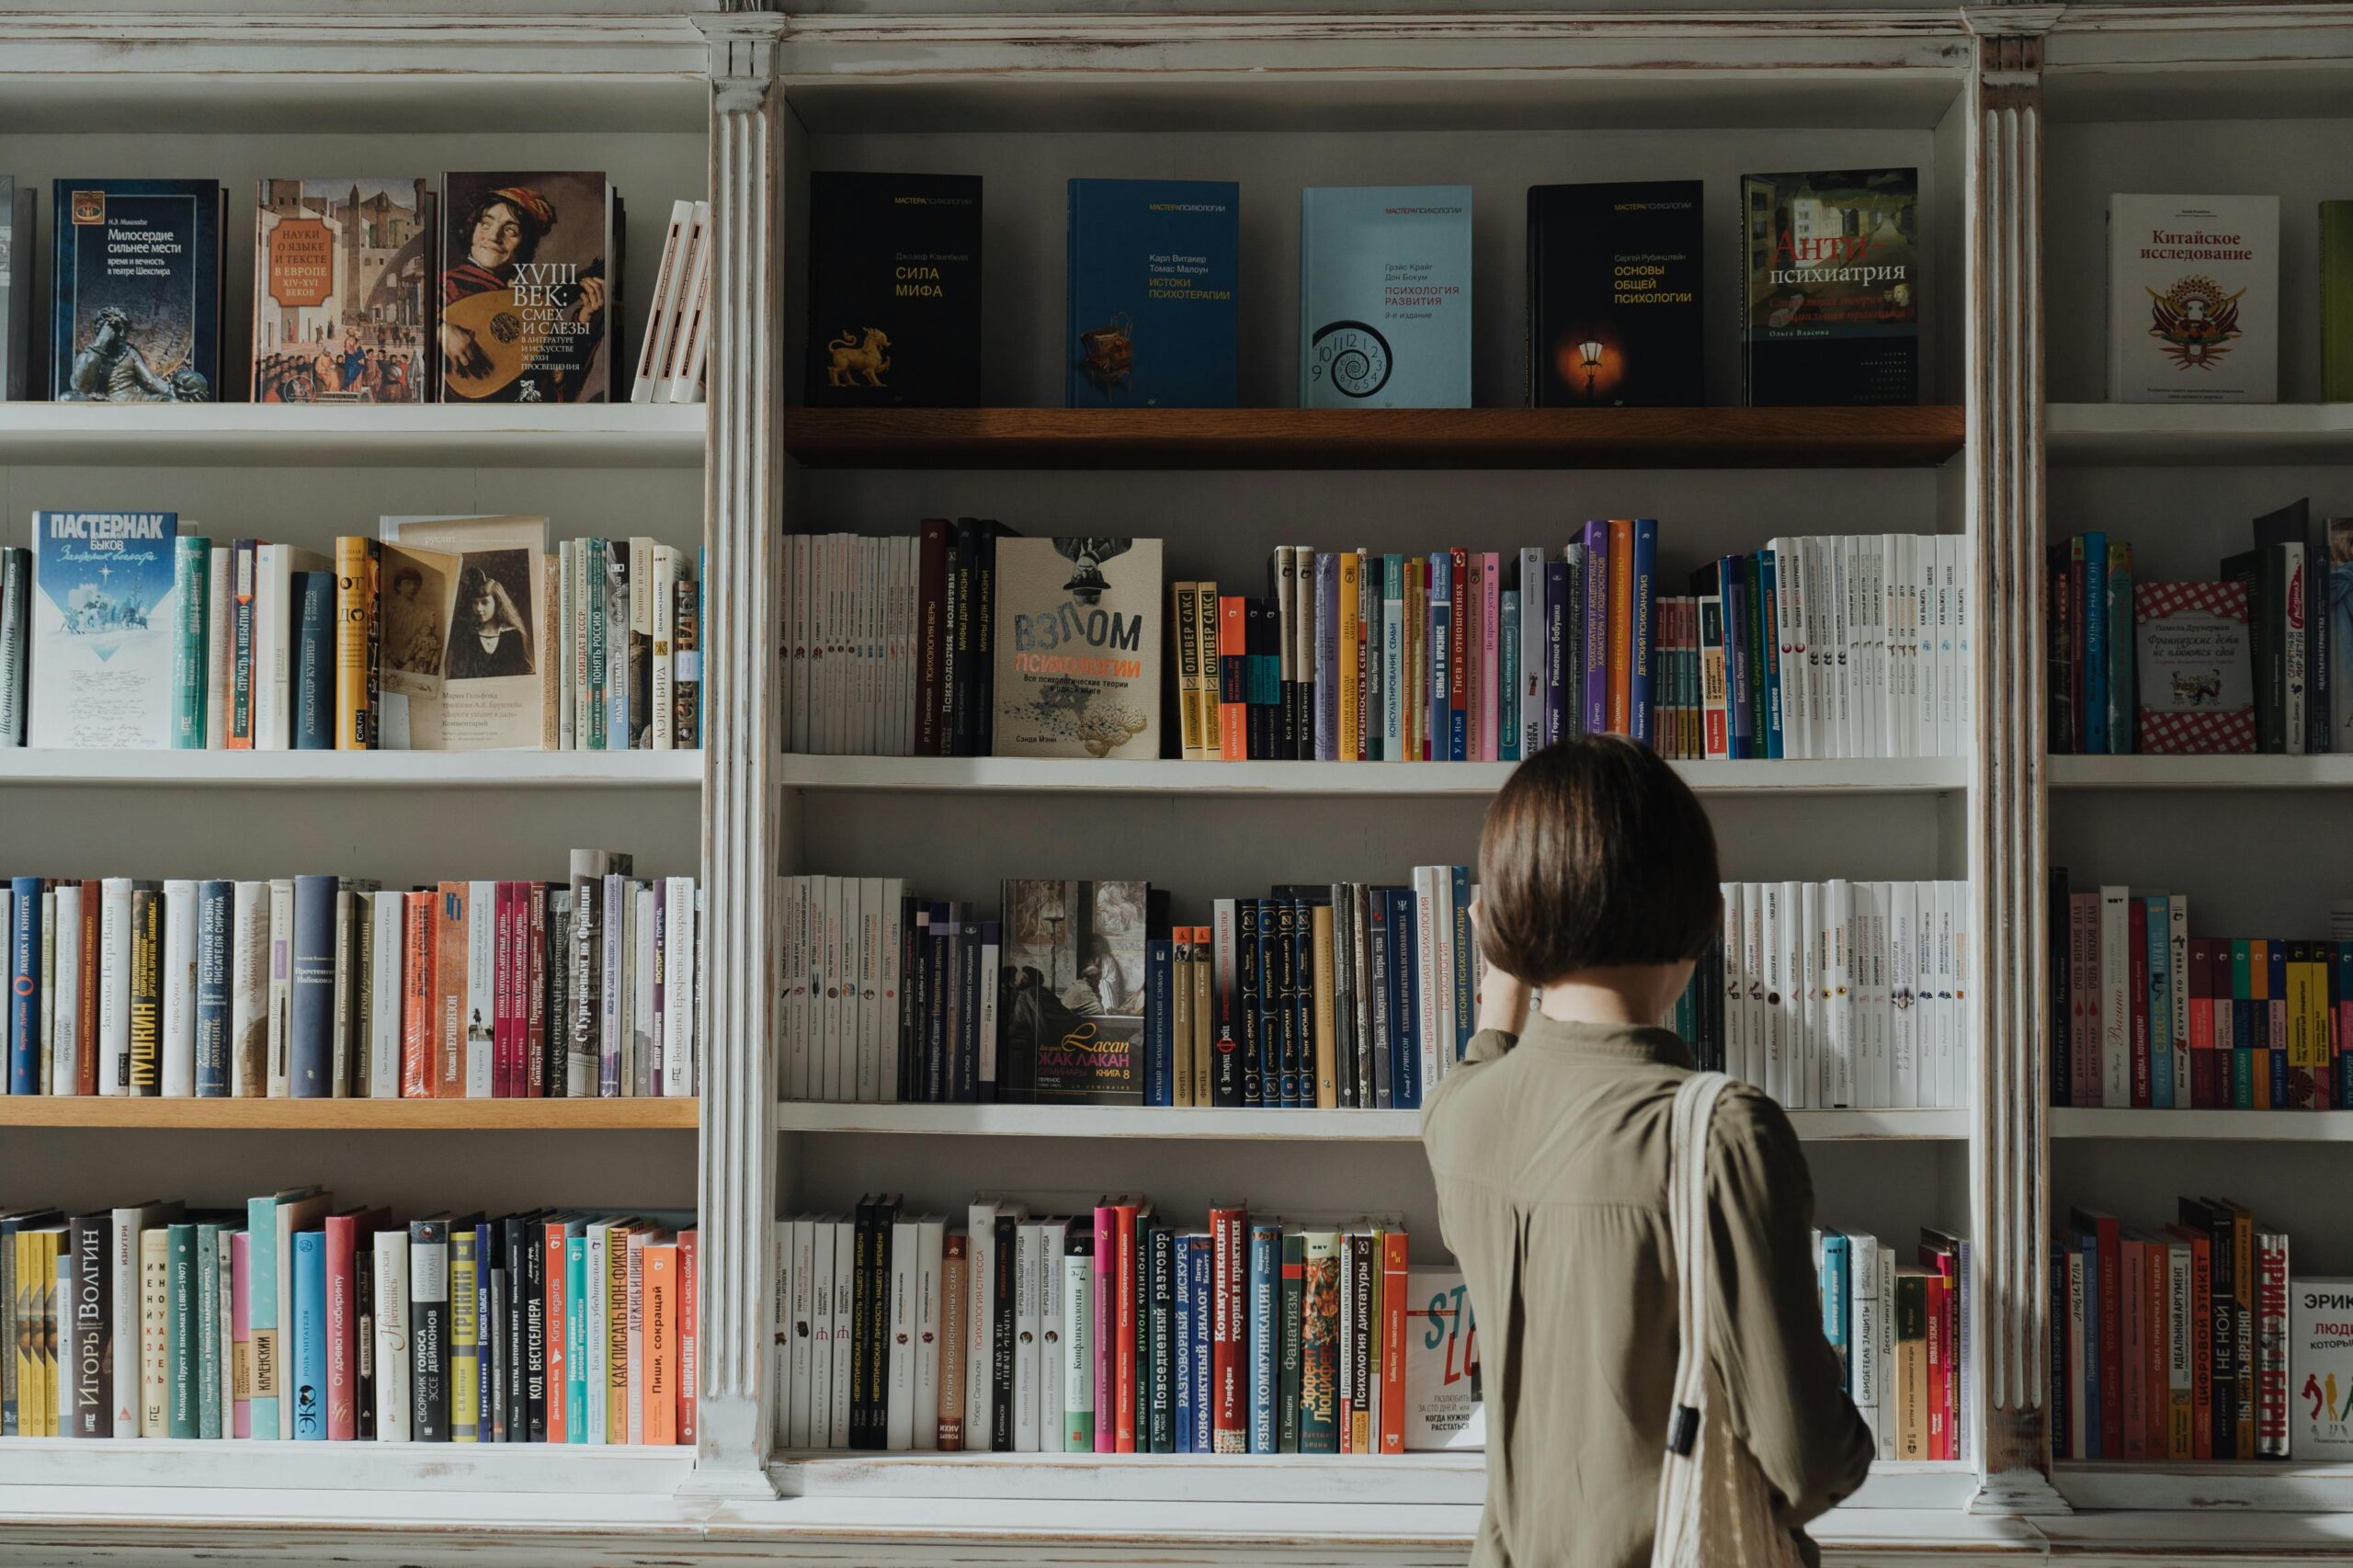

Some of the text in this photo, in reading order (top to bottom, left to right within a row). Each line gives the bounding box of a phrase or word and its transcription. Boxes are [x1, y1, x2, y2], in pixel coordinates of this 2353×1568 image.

[108, 229, 174, 244] Милосердие
[108, 244, 181, 253] сильнее мести
[278, 243, 324, 251] О ЯЗЫКЕ
[283, 231, 319, 239] НАУКИ
[2140, 247, 2252, 262] исследование
[2153, 230, 2240, 244] Китайское
[275, 267, 326, 276] В ЕВРОПЕ
[276, 255, 326, 264] И ТЕКСТЕ
[513, 263, 577, 285] XVIII
[896, 267, 939, 279] СИЛА
[1149, 255, 1206, 263] Карл Витакер
[1177, 266, 1209, 274] Малоун
[1615, 266, 1665, 276] ОСНОВЫ
[1769, 265, 1906, 287] психиатрия
[513, 286, 568, 307] ВЕК:
[896, 285, 942, 297] МИФА
[1149, 278, 1190, 287] ИСТОКИ
[1149, 290, 1230, 300] ПСИХОТЕРАПИИ
[1615, 278, 1656, 290] ОБЩЕЙ
[1615, 293, 1691, 303] ПСИХОЛОГИИ
[522, 309, 563, 321] СМЕХ
[523, 323, 589, 335] И СЛЕЗЫ
[51, 515, 165, 539] ПАСТЕРНАК
[91, 540, 123, 551] БЫКОВ
[239, 606, 249, 646] НЕБЫТИЮ
[578, 608, 586, 631] СССР:
[1015, 601, 1142, 652] ВЗЛОМ
[1181, 595, 1195, 671] ОЛИВЕР САКС
[1639, 574, 1648, 676] ДЕТСКИЙ ПСИХОАНАЛИЗ
[593, 612, 602, 683] ПОНЯТЬ РОССИЮ
[926, 602, 936, 681] ПСИХОЛОГИЯ ВЕРЫ
[943, 574, 955, 712] Психология молитвы
[239, 657, 249, 691] СТРАСТЬ
[615, 652, 623, 696] ШТЕМЛЕР
[1015, 651, 1141, 677] ПСИХОЛОГИИ
[1454, 667, 1462, 693] Гнев
[306, 638, 315, 734] АЛЕКСАНДР КУШНЕР
[20, 895, 30, 930] книгах
[578, 886, 590, 938] Франции
[20, 944, 29, 973] людях
[204, 898, 214, 983] ИСТИННАЯ ЖИЗНЬ
[214, 896, 224, 983] ПИСАТЕЛЯ СИРИНА
[580, 943, 588, 955] во
[15, 976, 34, 996] О
[576, 960, 590, 1029] Тургеневым
[1421, 897, 1433, 1053] ИНДИВИДУАЛЬНАЯ ПСИХОЛОГИЯ
[2177, 981, 2183, 991] ПО
[131, 1003, 155, 1085] ПУШКИН
[446, 995, 458, 1082] Михаил ГЕРШЕНЗОН
[1039, 1053, 1130, 1067] ЖАК ЛАКАН
[1096, 1069, 1130, 1079] КНИГА 8
[1215, 1219, 1227, 1342] Коммуникация:
[1232, 1221, 1243, 1341] теории и практики
[334, 1275, 344, 1329] лабиринту
[454, 1270, 472, 1336] ГРАНИН
[551, 1278, 562, 1342] Kind regards
[611, 1232, 627, 1388] КАК ПИСАТЬ НОН-ФИКШН
[1154, 1233, 1170, 1410] Повседневный разговор
[2173, 1267, 2184, 1369] ИДЕАЛЬНЫЙ АРГУМЕНТ
[426, 1310, 438, 1372] ДЕЙМОНОВ
[652, 1286, 664, 1394] Пиши, сокращай
[1176, 1244, 1189, 1408] РАЗГОВОРНЫЙ ДИСКУРС
[1284, 1290, 1299, 1370] Фанатизм
[1355, 1262, 1369, 1407] Психология диктатуры
[2195, 1255, 2209, 1405] ЦИФРОВОЙ ЭТИКЕТ
[2215, 1305, 2230, 1369] НЕ НОЙ
[178, 1357, 187, 1381] Пруст
[257, 1336, 271, 1391] КАМЕНСКИЙ
[335, 1338, 344, 1370] древа
[418, 1330, 426, 1372] ГОЛОСА
[528, 1298, 542, 1400] КОД БЕСТСЕЛЛЕРА
[682, 1335, 694, 1398] КОПИРАЙТИНГ
[1197, 1288, 1209, 1449] КОНФЛИКТНЫЙ ДИАЛОГ
[1257, 1283, 1271, 1450] ЯЗЫК КОММУНИКАЦИИ
[1862, 1306, 1871, 1401] СВИДЕТЕЛЬ ЗАЩИТЫ
[334, 1372, 343, 1386] От
[429, 1376, 438, 1401] ЭССЕ
[298, 1385, 316, 1434] ЭКО
[418, 1376, 426, 1423] СБОРНИК
